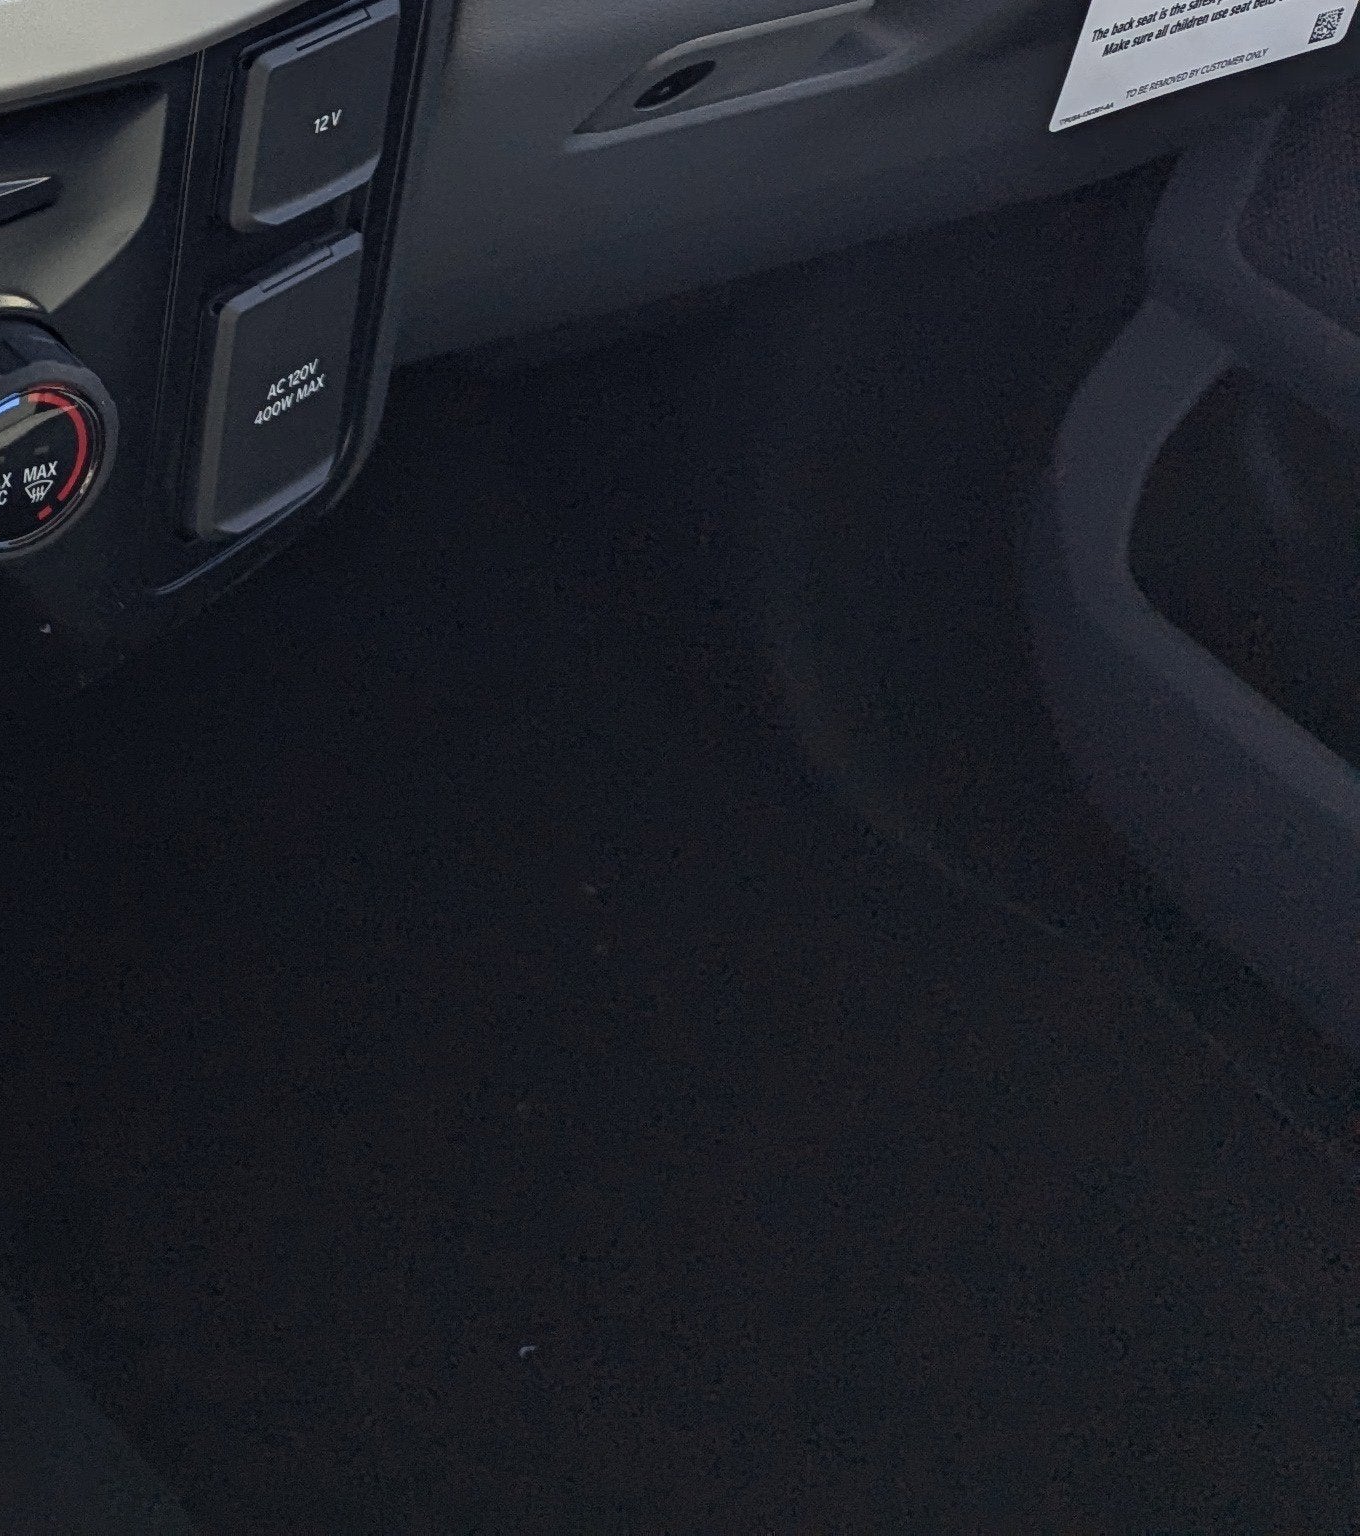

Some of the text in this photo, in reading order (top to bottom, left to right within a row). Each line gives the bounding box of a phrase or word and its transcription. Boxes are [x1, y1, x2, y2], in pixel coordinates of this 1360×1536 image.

[1091, 27, 1110, 43] The
[1110, 16, 1136, 36] back
[1134, 10, 1159, 29] seat
[1158, 7, 1169, 21] is
[1169, 3, 1188, 18] the
[1101, 38, 1131, 57] Make
[1130, 31, 1155, 48] sure
[1154, 23, 1171, 40] all
[1169, 13, 1210, 35] children
[1210, 8, 1230, 22] use
[1229, 0, 1253, 16] seat
[313, 109, 343, 134] 12 V
[253, 372, 326, 426] 400W MAX
[266, 357, 320, 400] AC 120V
[22, 461, 58, 483] MAX
